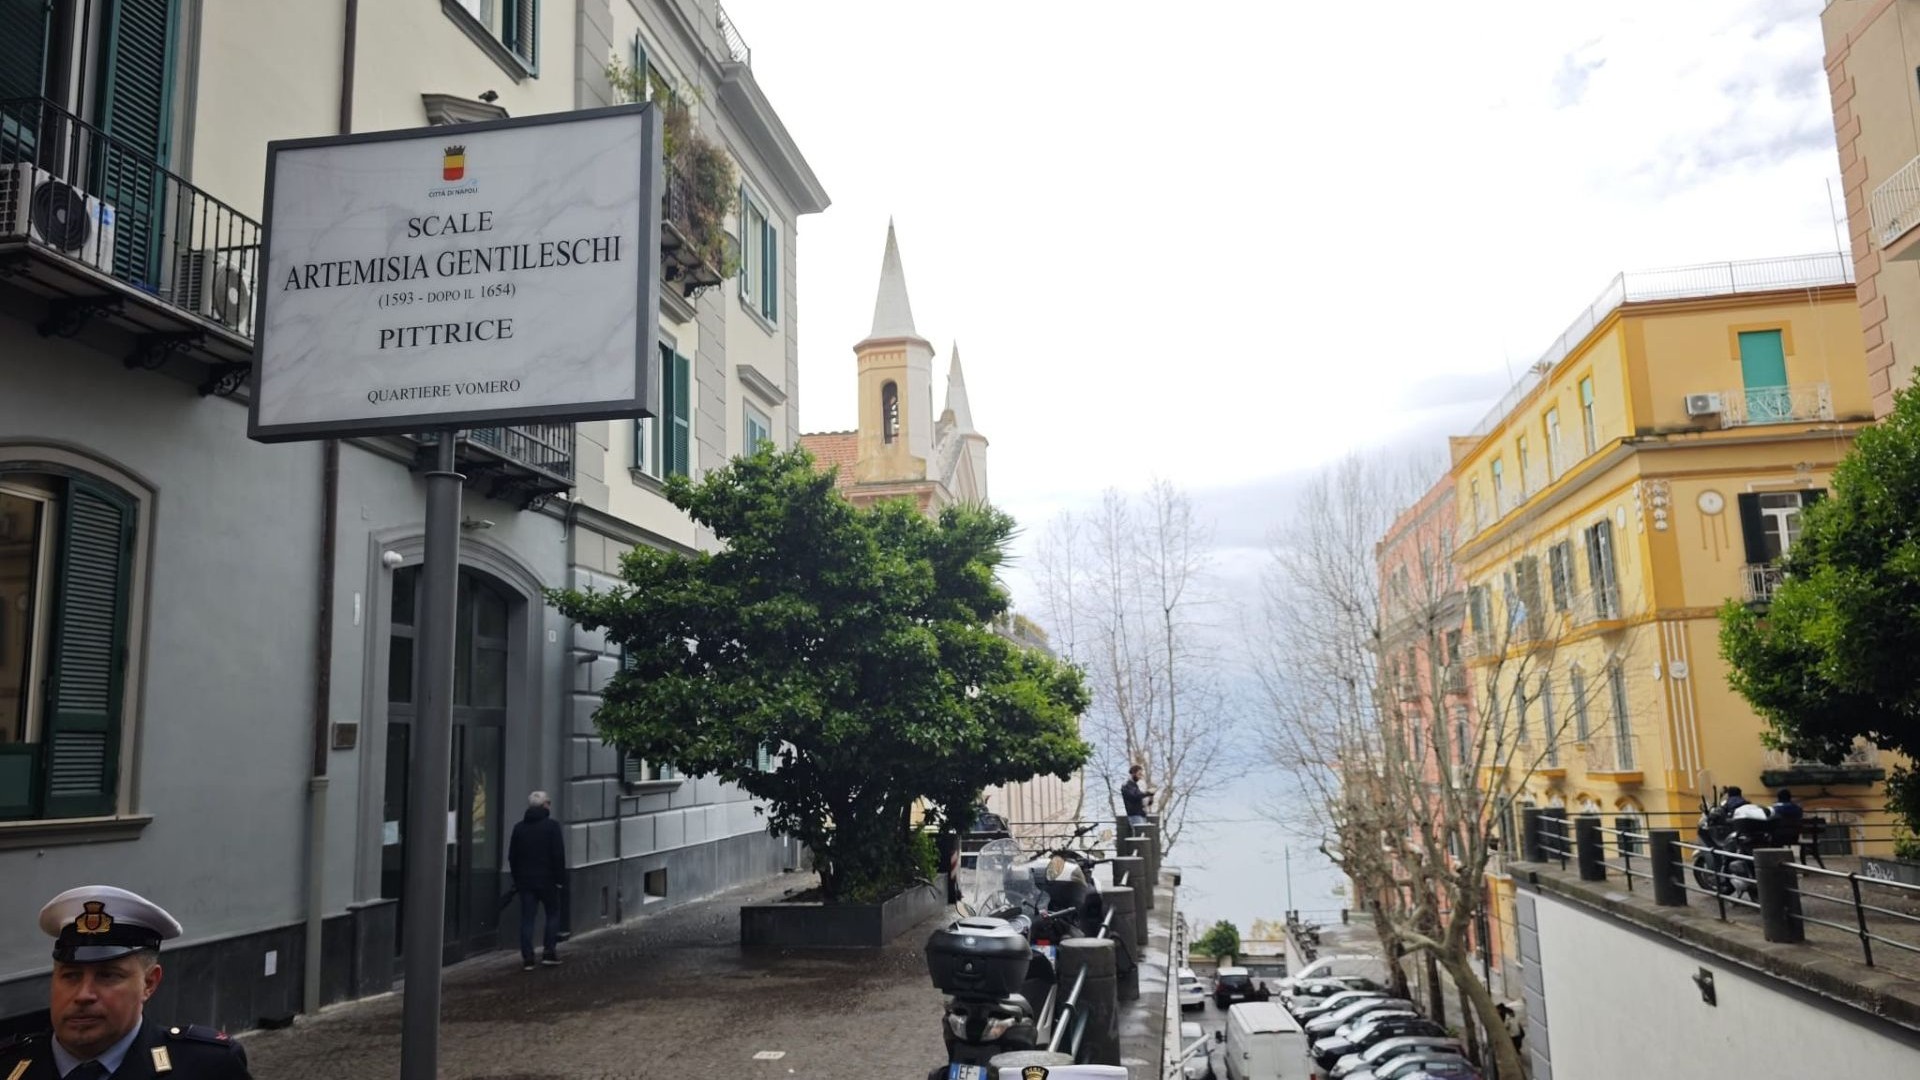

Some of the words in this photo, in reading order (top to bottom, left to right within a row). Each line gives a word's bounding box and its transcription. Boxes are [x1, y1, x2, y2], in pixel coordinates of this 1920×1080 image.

[455, 187, 478, 195] NAPOLI
[408, 210, 494, 239] SCALE
[284, 254, 430, 292] ARTEMISIA
[437, 236, 622, 279] GENTILESCHI
[378, 291, 414, 309] (1593
[427, 289, 461, 303] DOPO
[464, 288, 475, 300] IL
[481, 283, 517, 299] 1654)
[378, 318, 514, 349] PITTRICE
[367, 384, 451, 403] QUARTIERE
[455, 378, 521, 396] VOMERO
